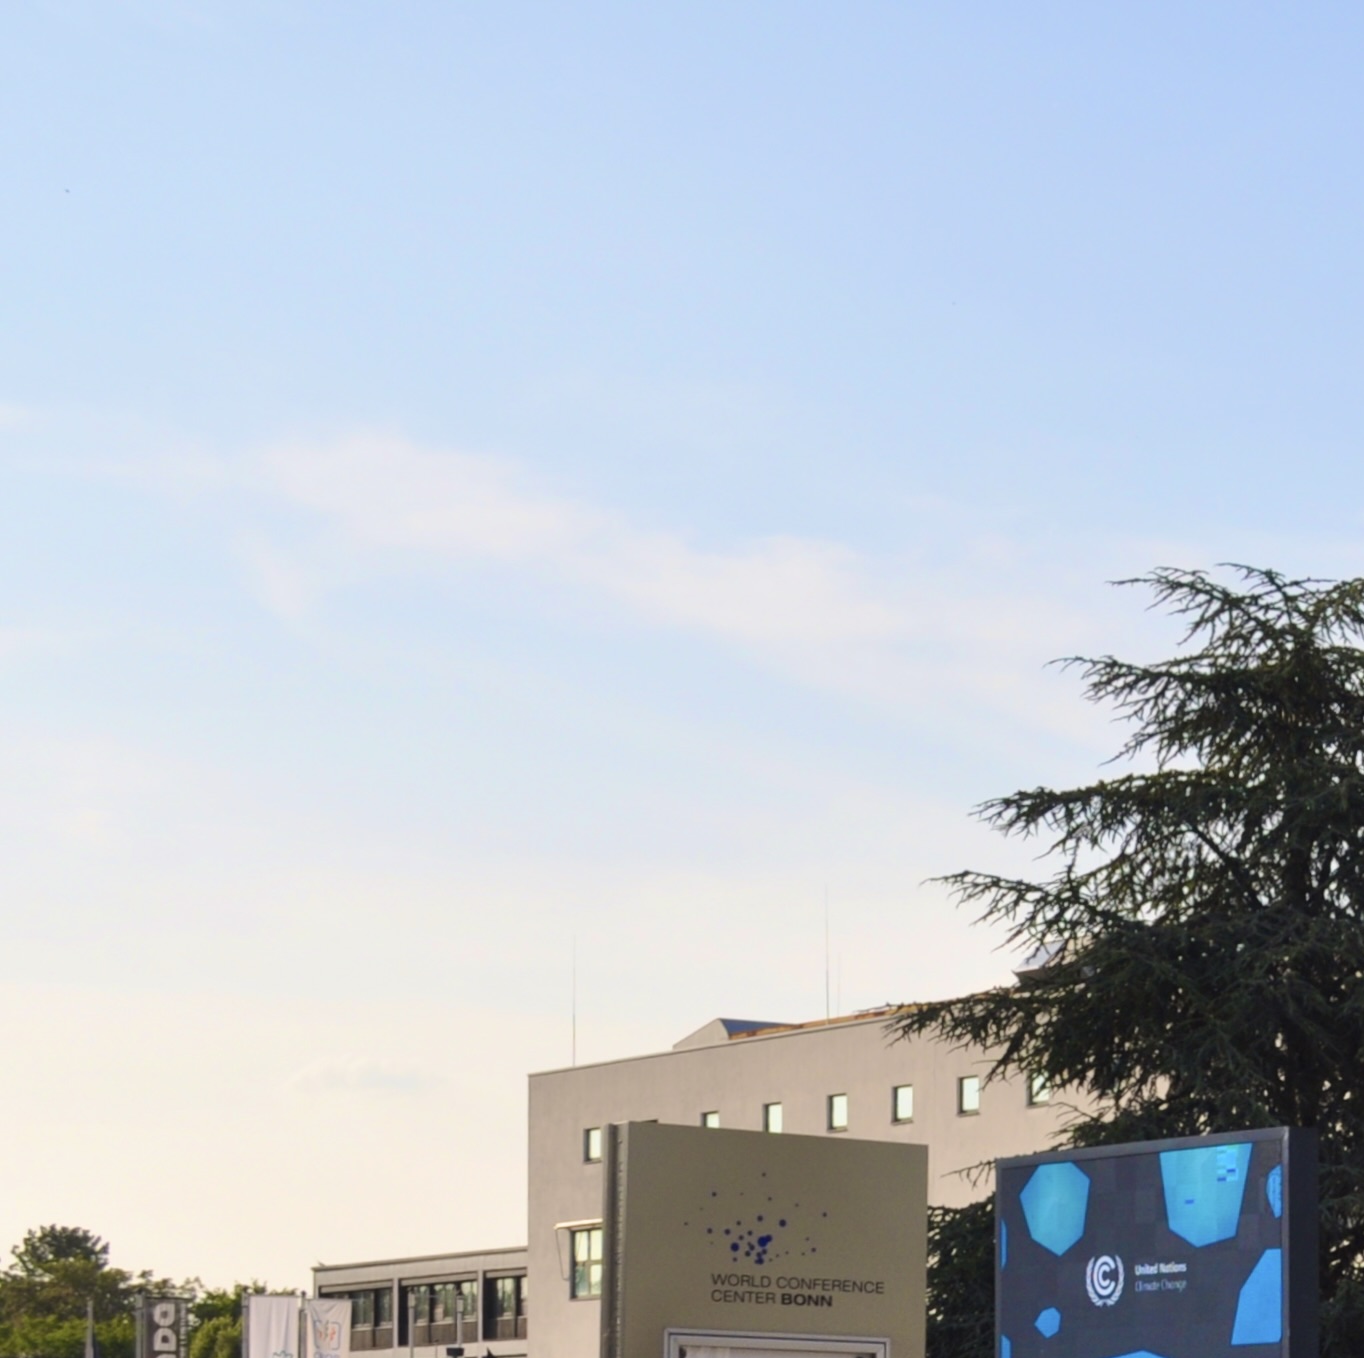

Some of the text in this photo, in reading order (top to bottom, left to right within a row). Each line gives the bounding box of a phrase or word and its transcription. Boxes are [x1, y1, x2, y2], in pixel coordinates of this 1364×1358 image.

[1135, 1262, 1187, 1276] United Nations
[711, 1274, 885, 1294] WORLD CONFERENCE
[711, 1289, 832, 1307] CENTER BONN
